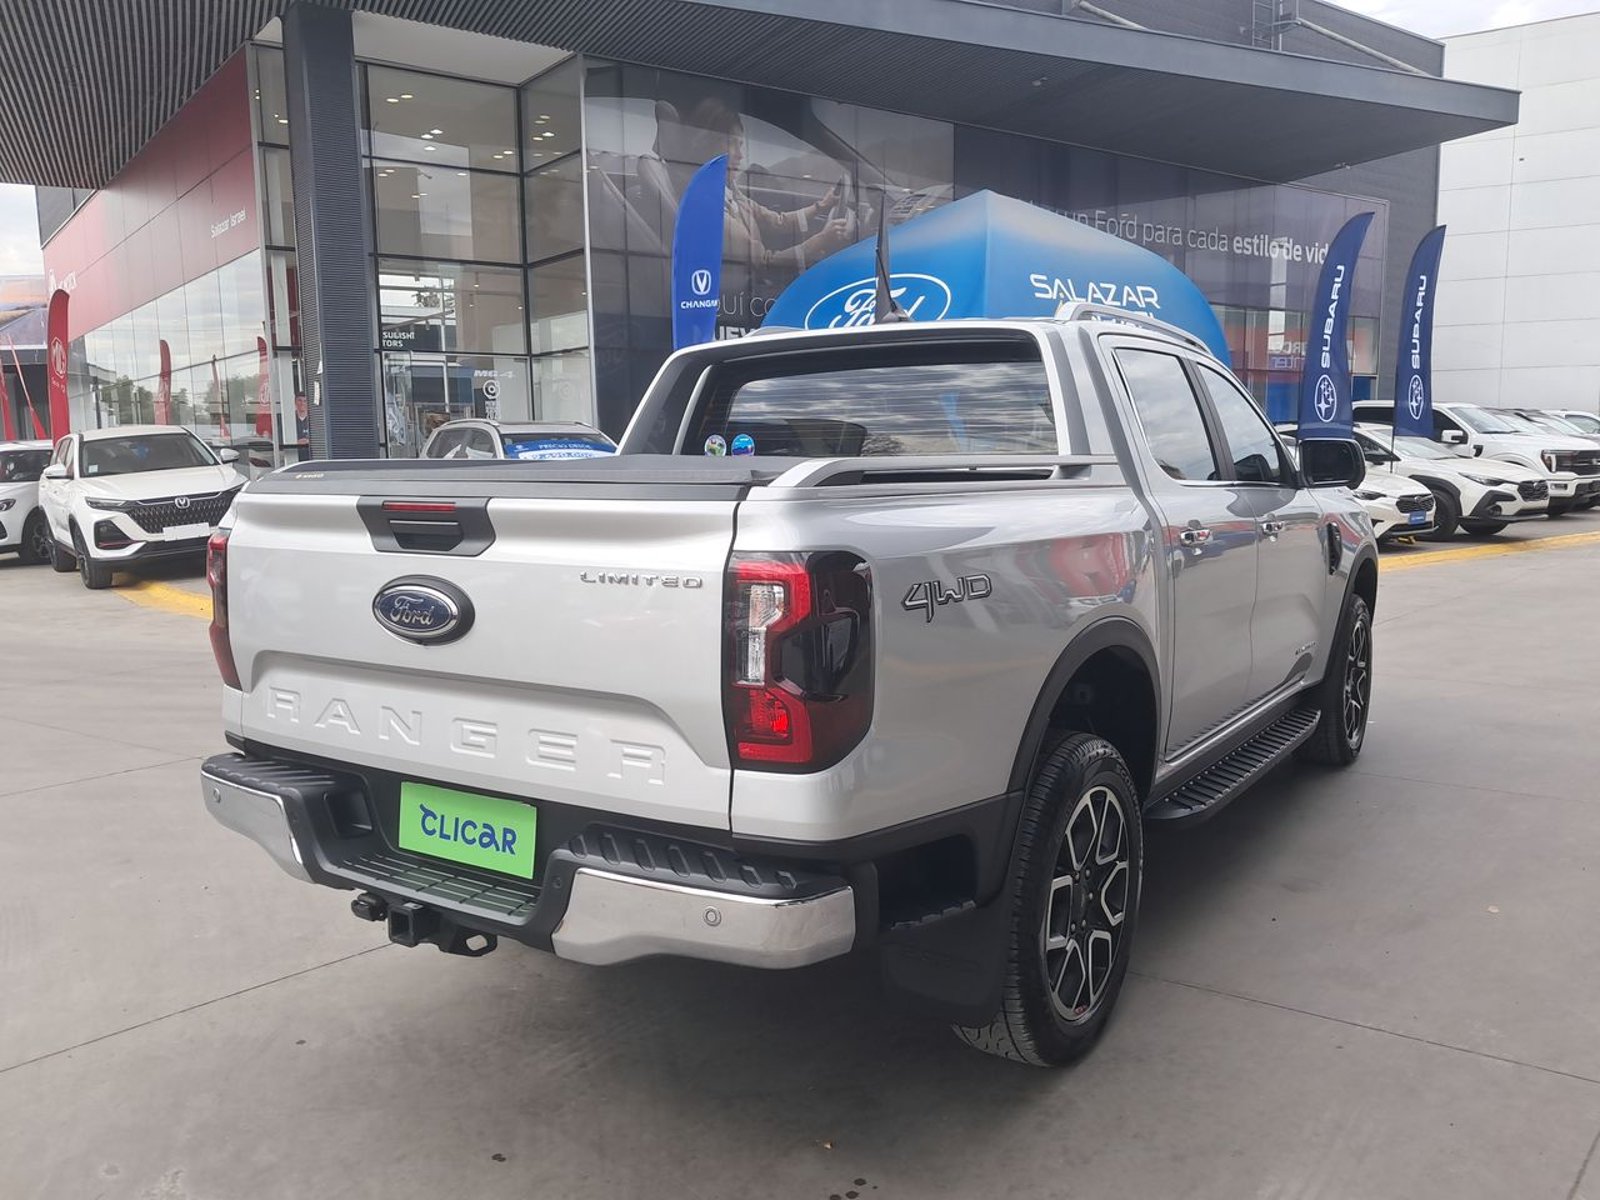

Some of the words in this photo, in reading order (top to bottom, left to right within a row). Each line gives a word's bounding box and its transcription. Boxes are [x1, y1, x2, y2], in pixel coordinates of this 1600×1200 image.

[1095, 210, 1138, 240] Ford
[1143, 223, 1182, 246] para
[1187, 227, 1229, 252] cada
[1233, 234, 1279, 260] estilo
[1283, 238, 1302, 261] de
[1305, 241, 1329, 265] vid
[1029, 273, 1161, 309] SALAZAR
[1321, 265, 1345, 369] SUBARU
[382, 339, 404, 347] TORS
[1411, 275, 1427, 370] SUBARU
[579, 571, 704, 589] LIMITED
[901, 573, 993, 625] 4WD
[388, 594, 435, 627] Ford
[264, 684, 668, 787] RANGER
